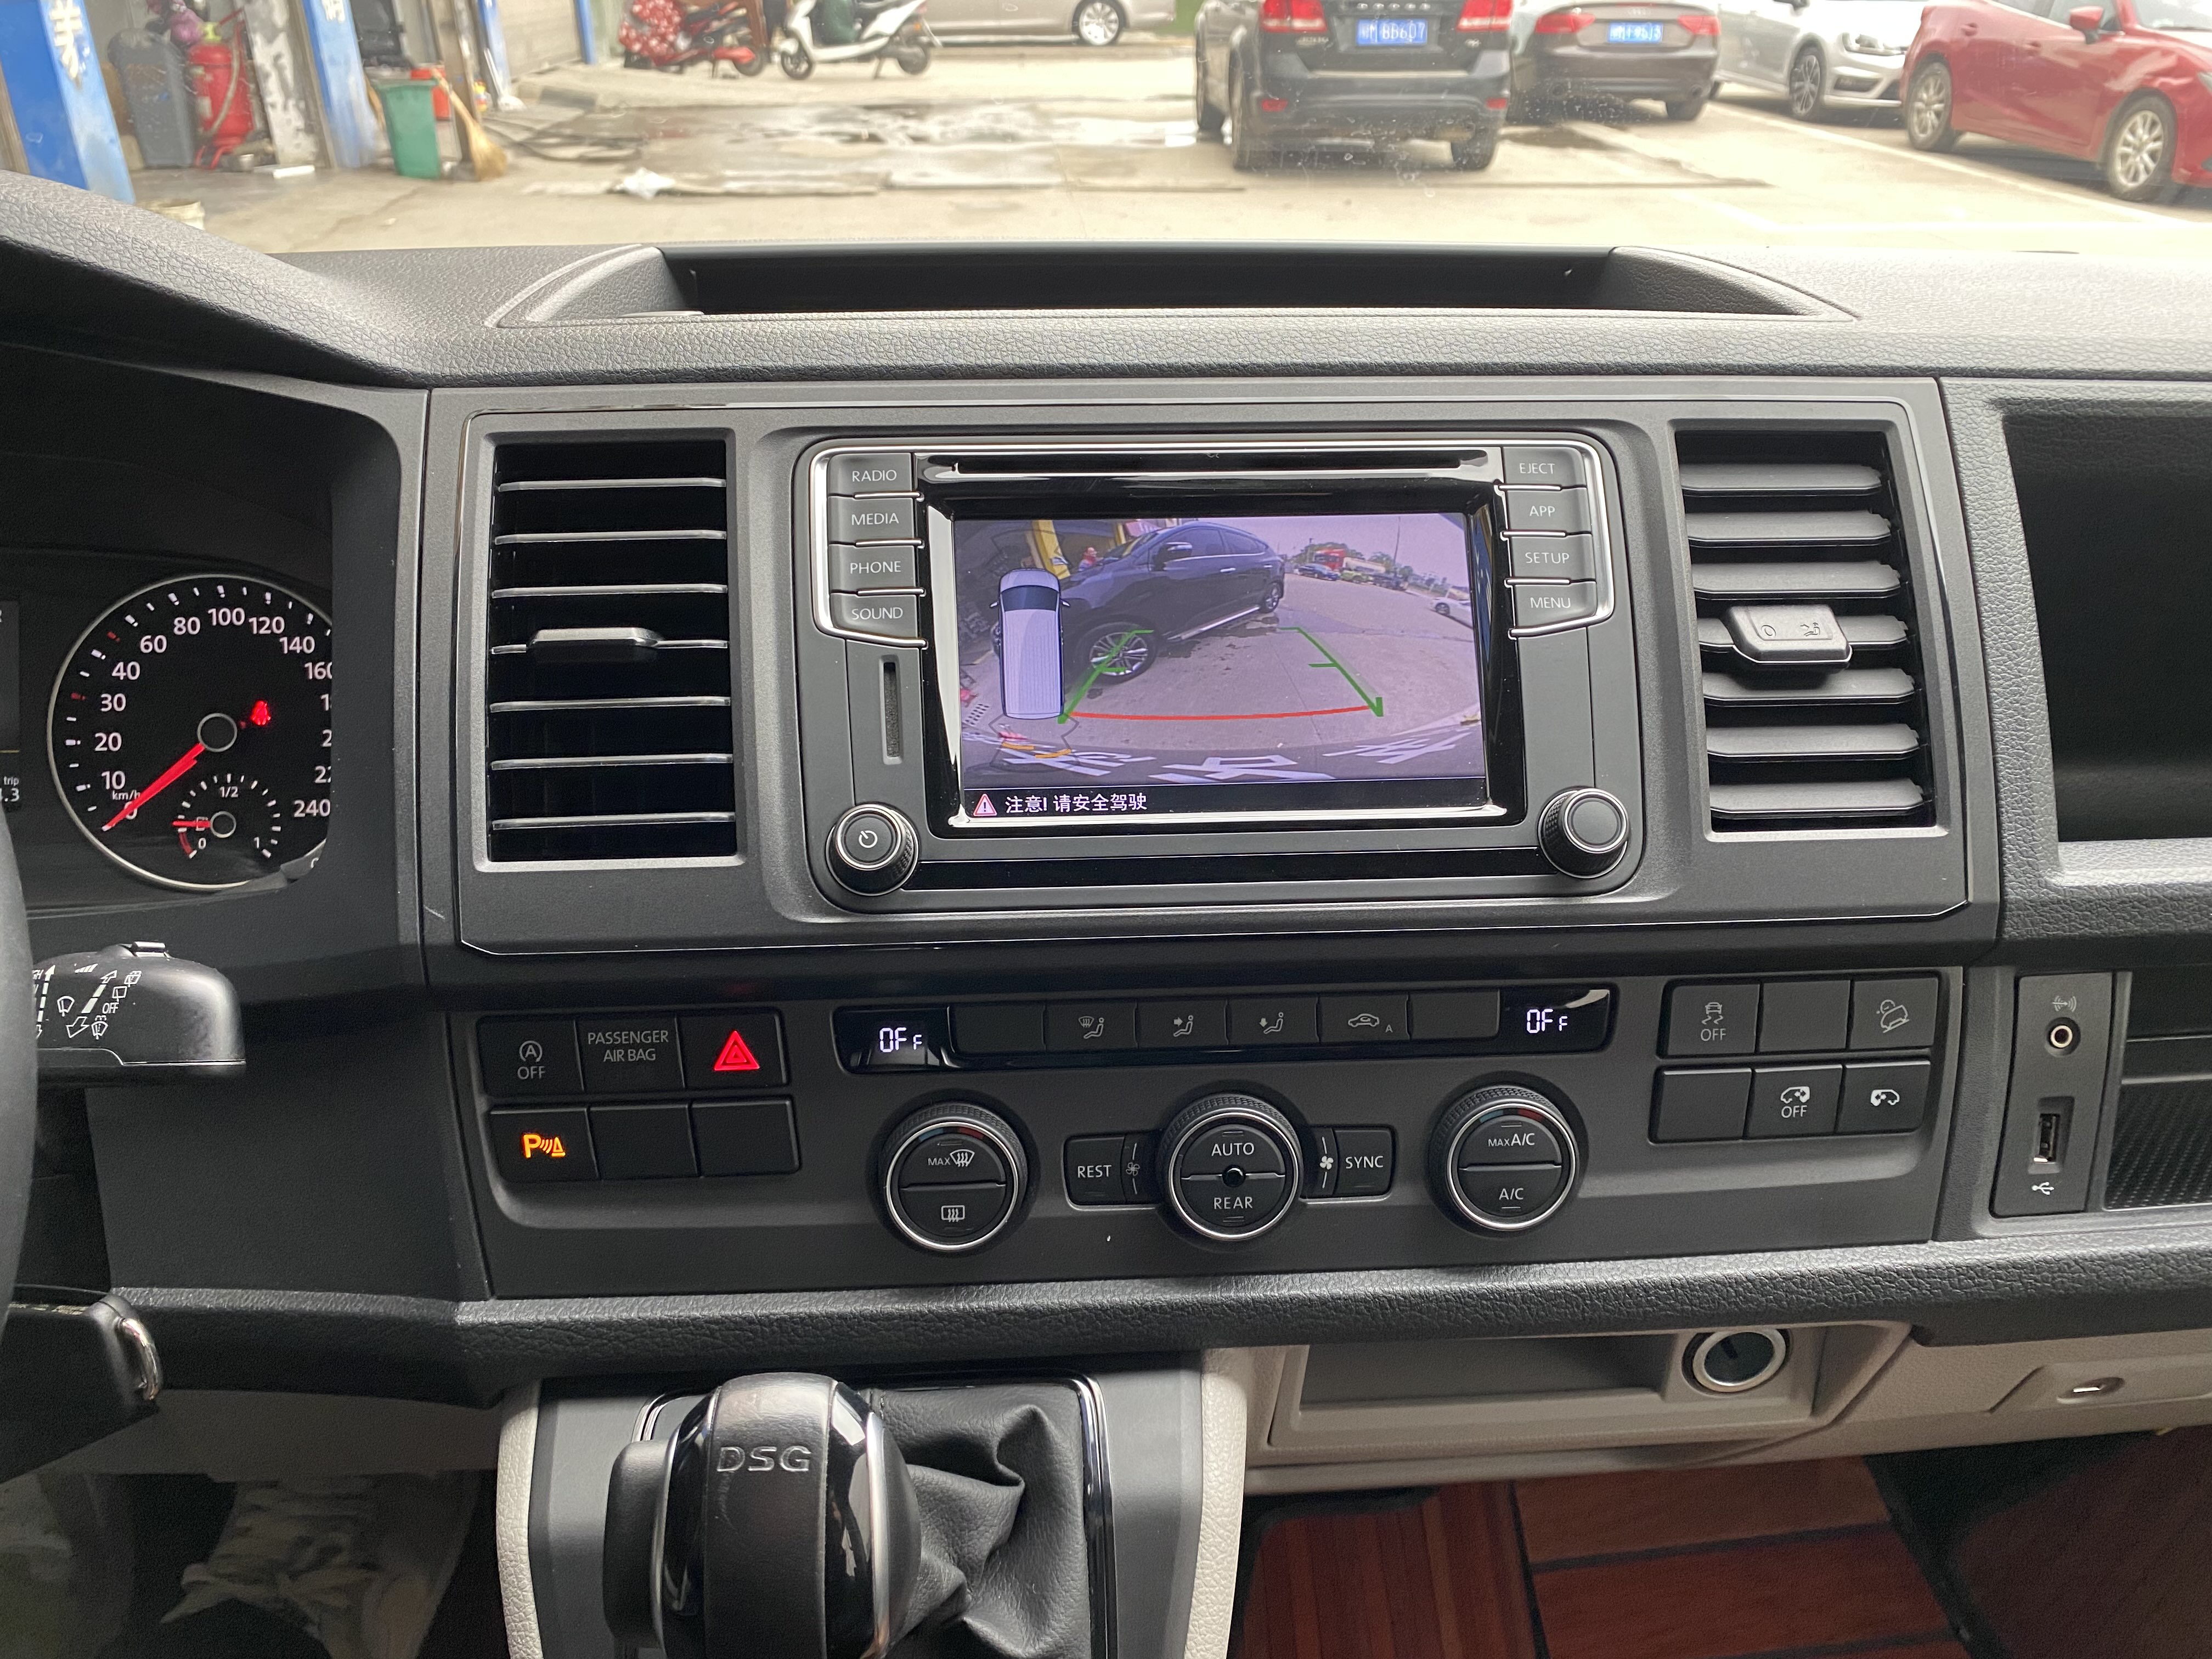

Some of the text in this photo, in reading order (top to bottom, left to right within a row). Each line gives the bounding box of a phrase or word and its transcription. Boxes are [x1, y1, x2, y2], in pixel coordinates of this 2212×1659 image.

[1519, 462, 1555, 475] EJECT
[852, 470, 898, 483] RADIO
[1529, 505, 1556, 517] APP
[851, 512, 900, 526] MEDIA
[1525, 551, 1570, 565] SETUP
[849, 561, 901, 574] PHONE
[1530, 596, 1571, 609] MENU
[207, 607, 245, 626] 100
[851, 606, 904, 620] SOUND
[173, 616, 201, 635] 80
[249, 616, 285, 635] 120
[140, 635, 167, 653] 60
[279, 636, 315, 654] 140
[111, 661, 140, 680] 40
[100, 693, 126, 712] 30
[94, 732, 122, 752] 20
[3, 776, 20, 787] trip
[101, 770, 126, 790] 10
[112, 789, 140, 800] km/h
[219, 786, 239, 798] 1/2
[294, 799, 331, 817] 240
[1052, 792, 1148, 812] 请安全驾驶
[198, 837, 206, 850] 0
[253, 837, 260, 849] 1
[102, 1002, 120, 1014] OFF
[588, 1030, 669, 1045] PASSENGER
[1700, 1028, 1727, 1042] OFF
[603, 1048, 657, 1063] AIR BAG
[517, 1066, 546, 1080] OFF
[1781, 1104, 1808, 1119] OFF
[1487, 1132, 1536, 1147] MAX A/C
[1211, 1142, 1255, 1157] AUTO
[927, 1156, 951, 1166] MAX
[1345, 1155, 1384, 1170] SYNC
[1077, 1164, 1113, 1178] REST
[1498, 1187, 1525, 1201] A/C
[1213, 1195, 1254, 1210] REAR
[716, 1446, 811, 1472] DSG
